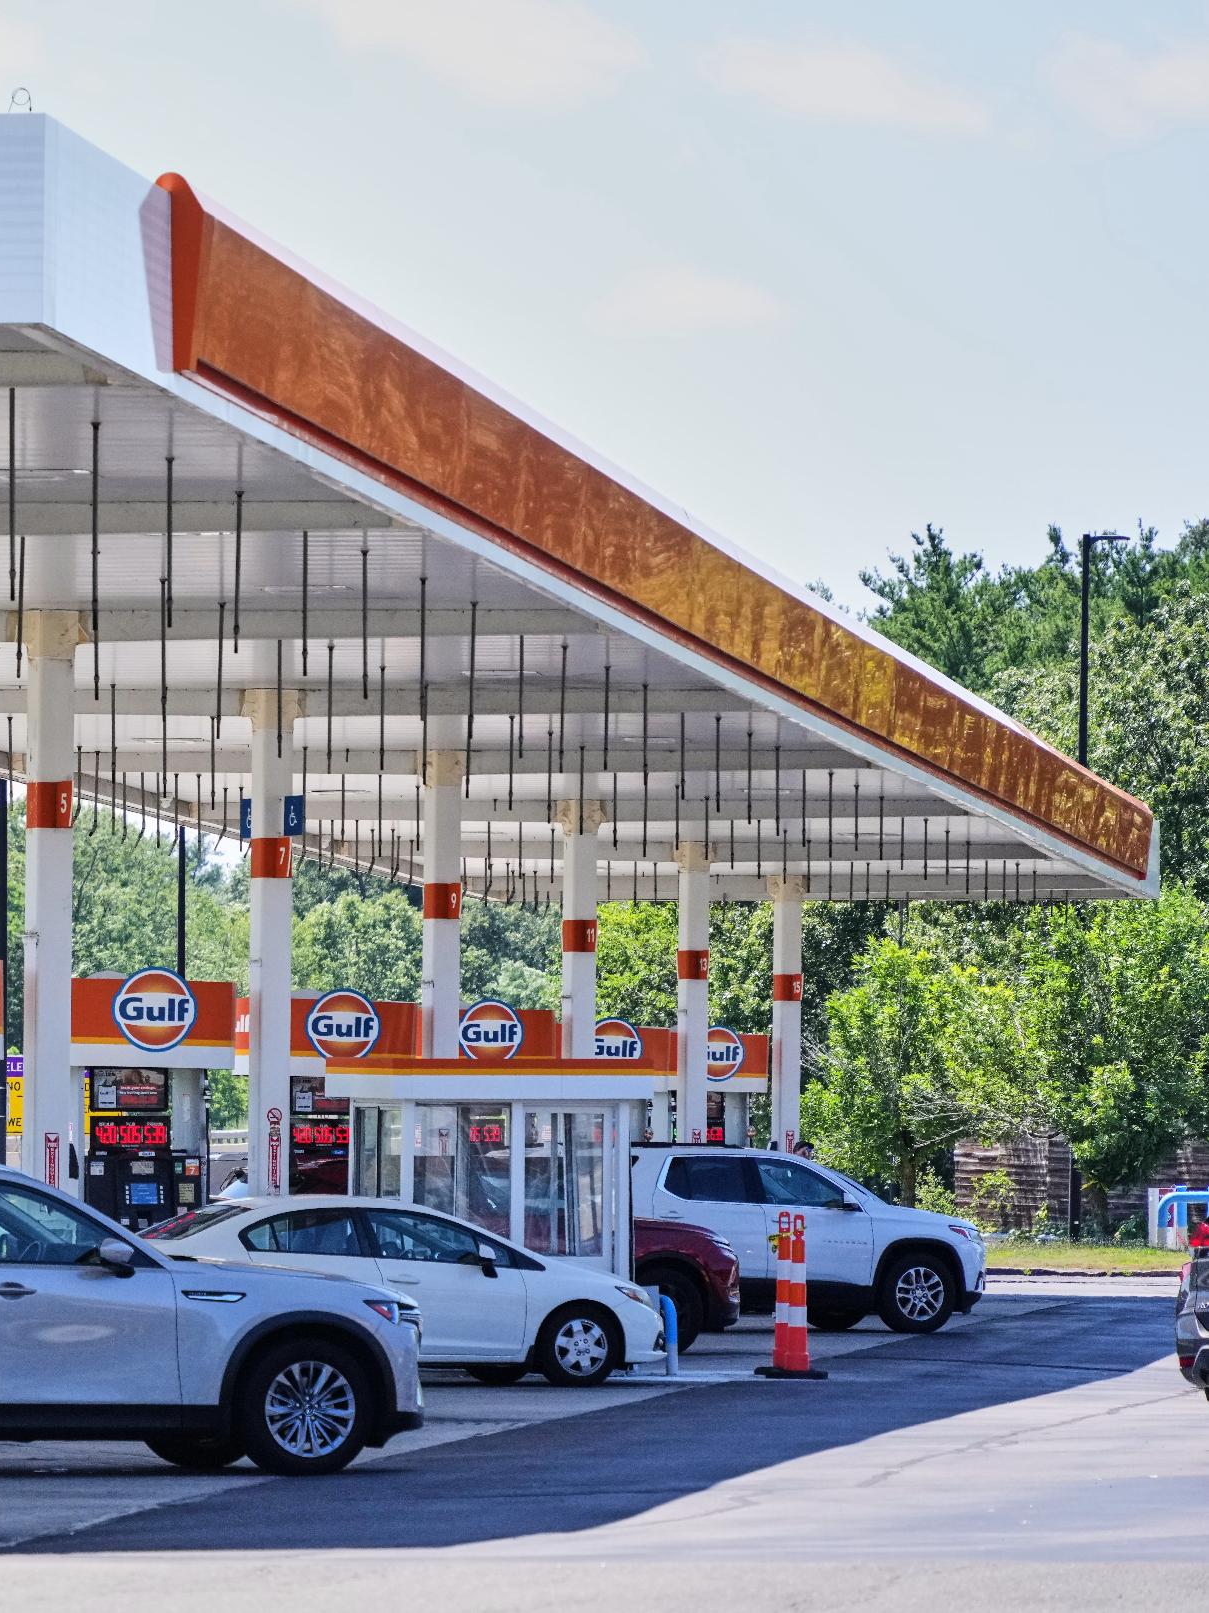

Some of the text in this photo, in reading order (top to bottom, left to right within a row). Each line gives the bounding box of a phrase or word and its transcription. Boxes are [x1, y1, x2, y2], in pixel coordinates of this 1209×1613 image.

[60, 792, 68, 814] 5
[279, 847, 286, 865] 7
[450, 892, 457, 909] 9
[586, 928, 595, 943] 11
[699, 958, 708, 971] 13
[792, 981, 801, 993] 15
[118, 996, 190, 1022] Gulf
[311, 1015, 375, 1039] Gulf
[461, 1023, 519, 1044] Gulf
[708, 1045, 740, 1062] ulf
